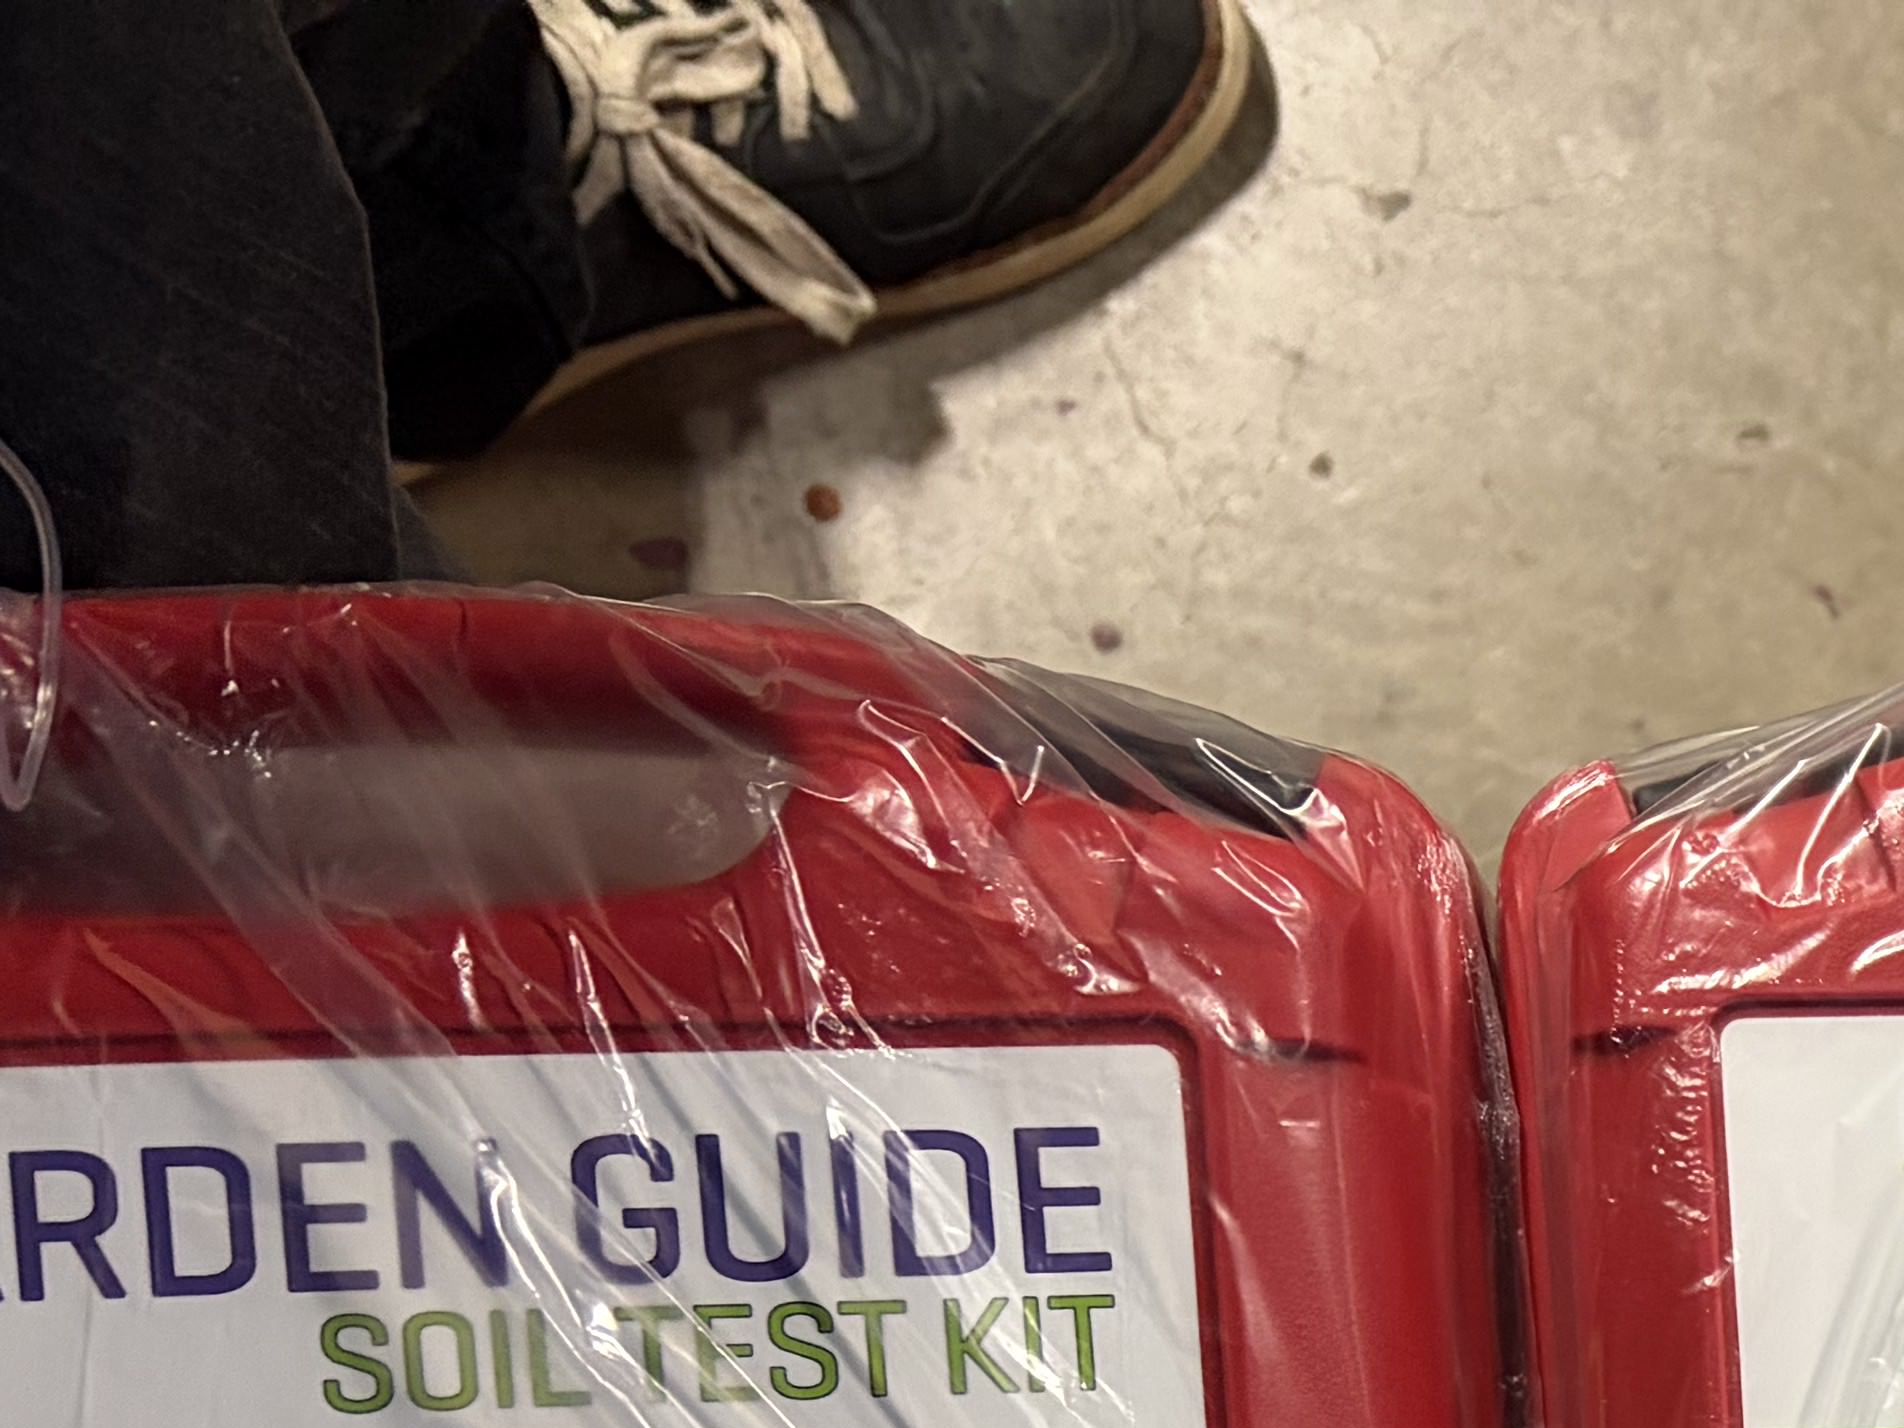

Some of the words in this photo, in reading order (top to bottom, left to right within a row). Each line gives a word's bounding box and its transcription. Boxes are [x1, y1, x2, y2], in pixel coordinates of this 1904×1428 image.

[0, 1140, 510, 1302] RDEN
[569, 1127, 1113, 1285] GUIDE
[320, 1308, 592, 1414] SOIL
[613, 1298, 905, 1405] TEST
[945, 1294, 1115, 1396] KIT
